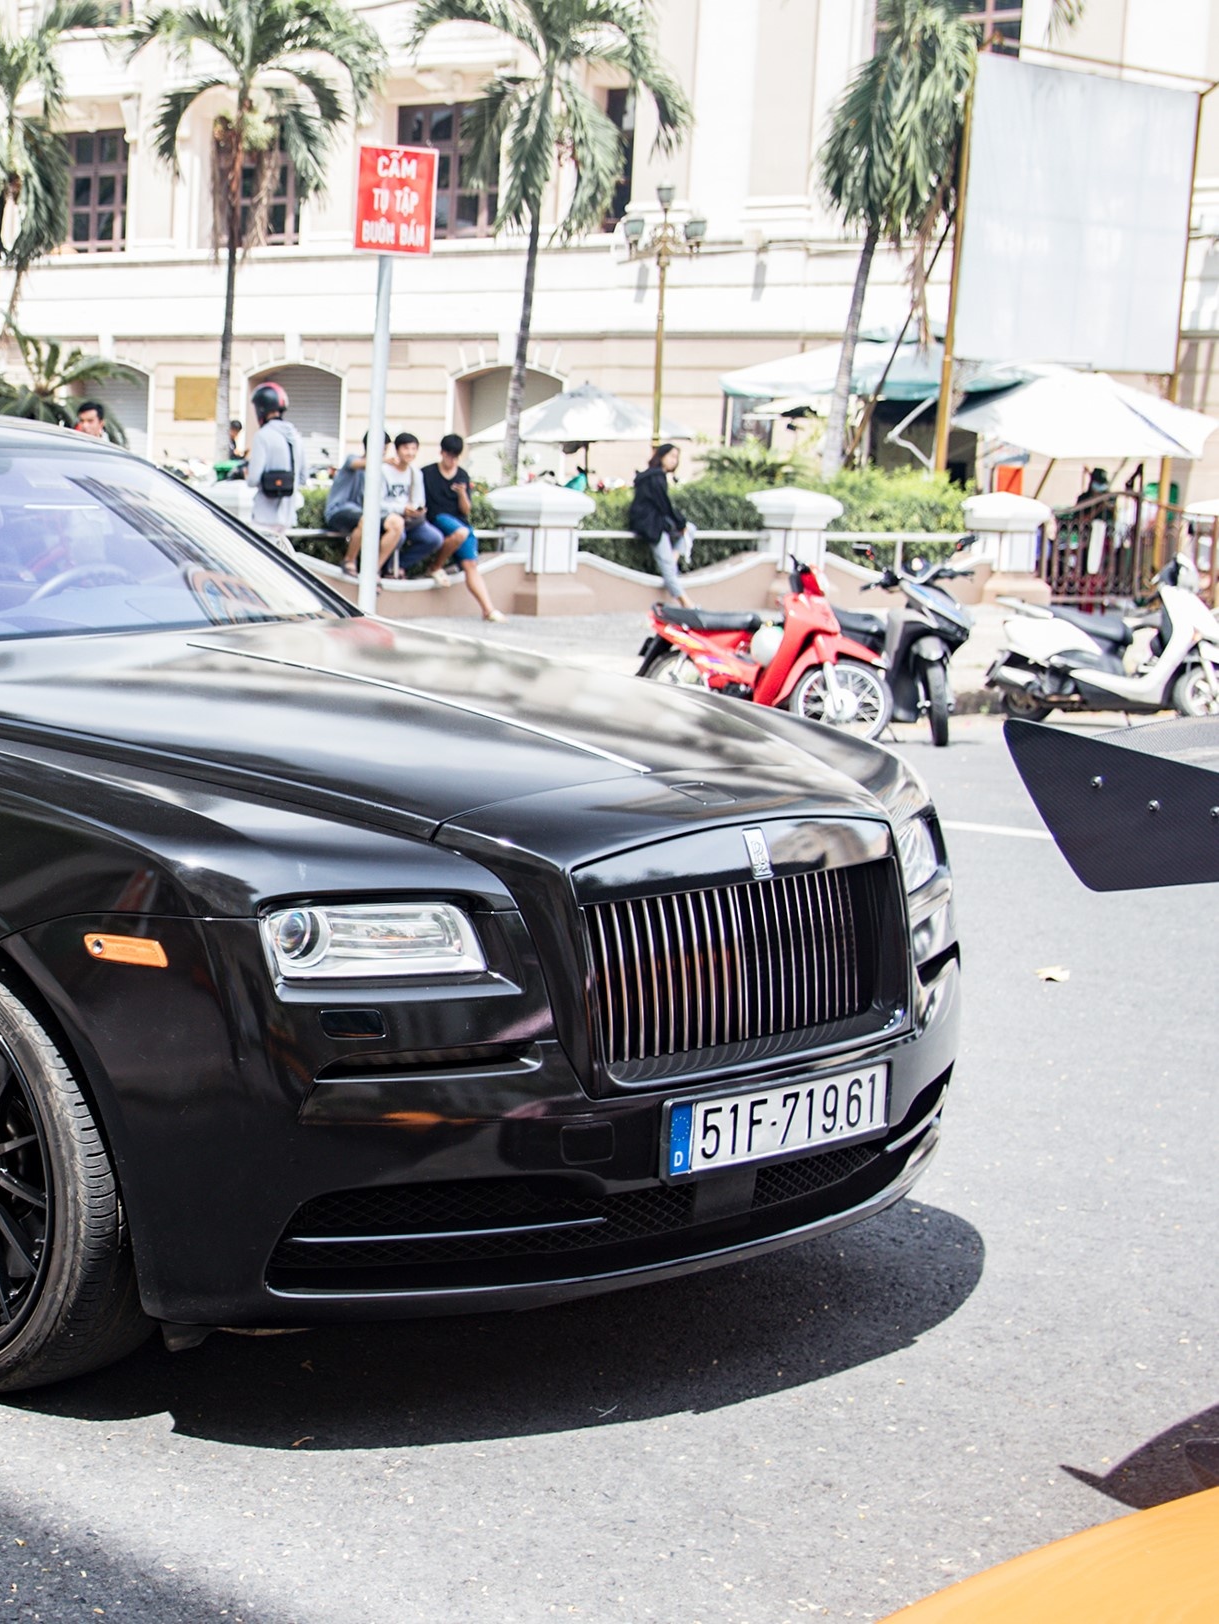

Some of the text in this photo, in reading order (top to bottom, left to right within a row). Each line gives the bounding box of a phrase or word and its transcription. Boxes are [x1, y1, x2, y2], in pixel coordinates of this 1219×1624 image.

[377, 150, 418, 180] CẤM
[372, 186, 420, 217] TỤ TẬP
[361, 217, 426, 247] BUÔN BÁN
[700, 1073, 876, 1160] 51F-719.61
[673, 1151, 684, 1167] D
